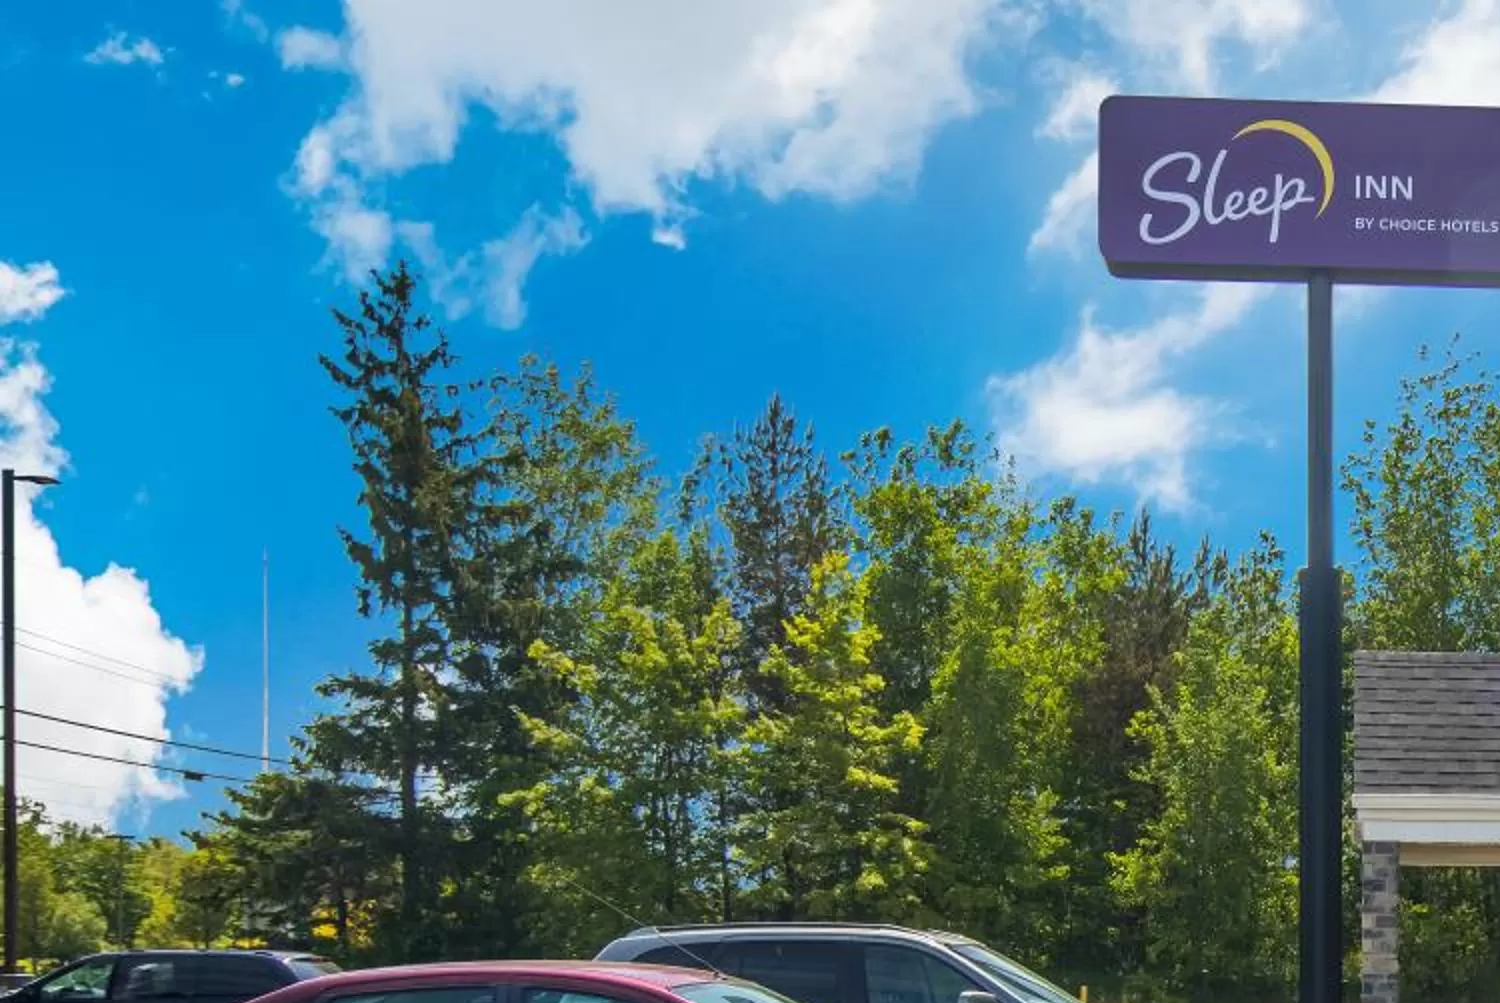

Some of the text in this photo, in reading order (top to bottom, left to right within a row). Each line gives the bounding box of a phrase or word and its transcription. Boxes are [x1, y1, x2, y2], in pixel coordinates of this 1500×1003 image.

[1139, 149, 1414, 245] Sleep INN
[1355, 217, 1499, 233] BY CHOICE HOTELS
